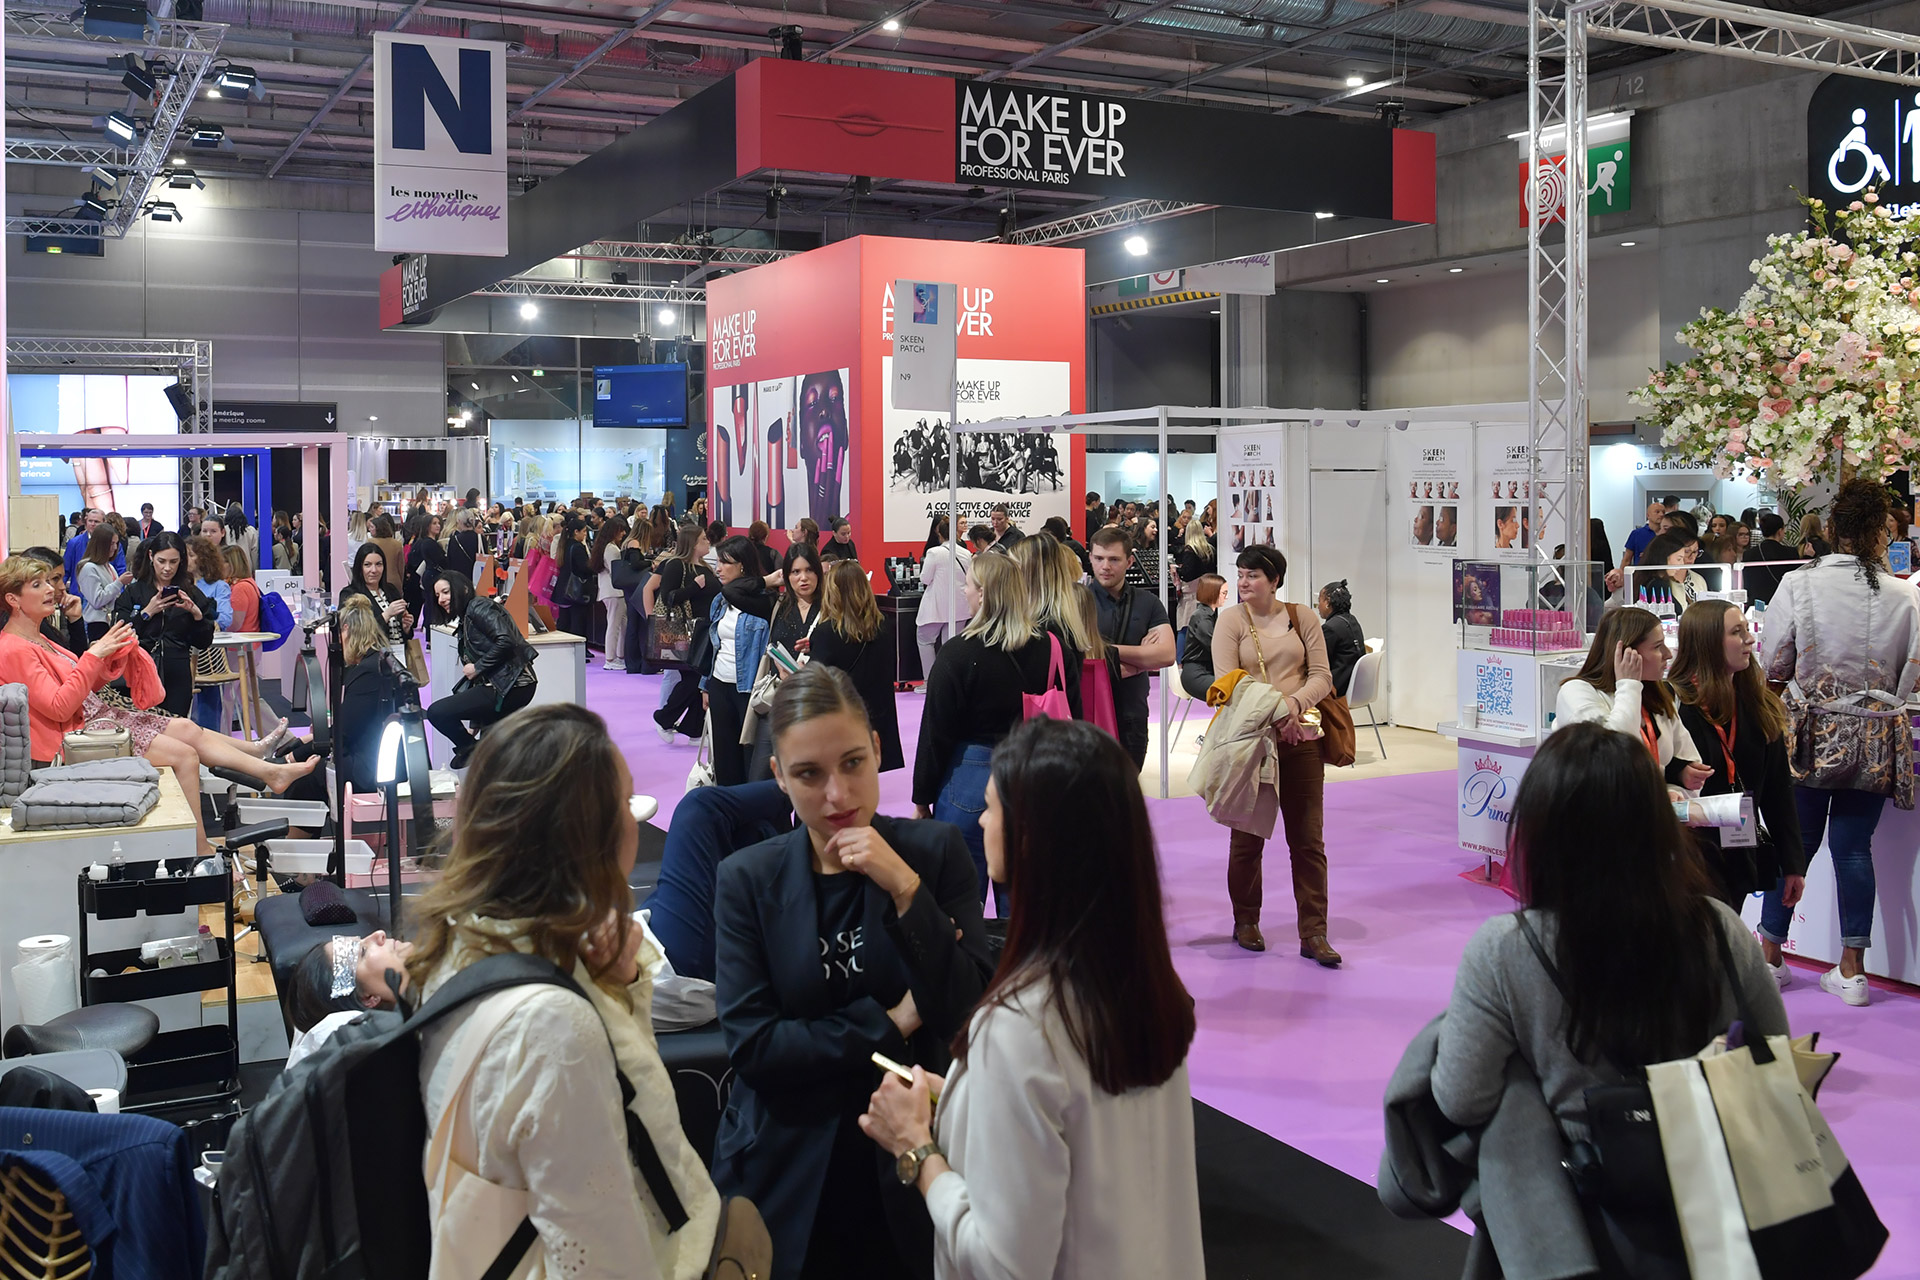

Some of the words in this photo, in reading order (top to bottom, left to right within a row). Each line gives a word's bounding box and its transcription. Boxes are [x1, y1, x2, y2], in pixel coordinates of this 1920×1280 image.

[1625, 76, 1644, 95] 12
[391, 42, 492, 155] N
[960, 85, 1070, 135] MAKE
[1081, 100, 1126, 139] UP
[960, 125, 1033, 169] FOR
[1044, 133, 1126, 177] EVER
[960, 163, 1040, 182] PROFESSIONAL
[1042, 170, 1070, 185] PARIS
[391, 186, 410, 198] les
[414, 188, 478, 201] nouvelles
[385, 194, 501, 222] esthétiques
[403, 258, 418, 287] MAKE
[419, 254, 428, 278] UP
[403, 283, 414, 308] FOR
[414, 277, 428, 303] EVER
[713, 312, 740, 340] MAKE
[743, 309, 756, 335] UP
[956, 312, 994, 336] VER
[713, 338, 731, 363] FOR
[733, 333, 757, 360] EVER
[900, 335, 924, 344] SKEEN
[900, 345, 925, 353] PATCH
[900, 373, 911, 381] N9
[956, 380, 985, 390] MAKE
[988, 381, 1000, 391] UP
[956, 390, 974, 400] FOR
[978, 390, 1000, 400] EVER
[20, 470, 51, 478] erience
[1636, 461, 1667, 470] D-LAB
[926, 502, 933, 510] A
[935, 502, 981, 510] COLECTIVE
[974, 510, 991, 518] YOU
[1008, 510, 1031, 518] RVICE
[284, 581, 299, 590] pbi
[1462, 771, 1514, 823] Princ
[1462, 841, 1507, 857] WWW.PRINCESS
